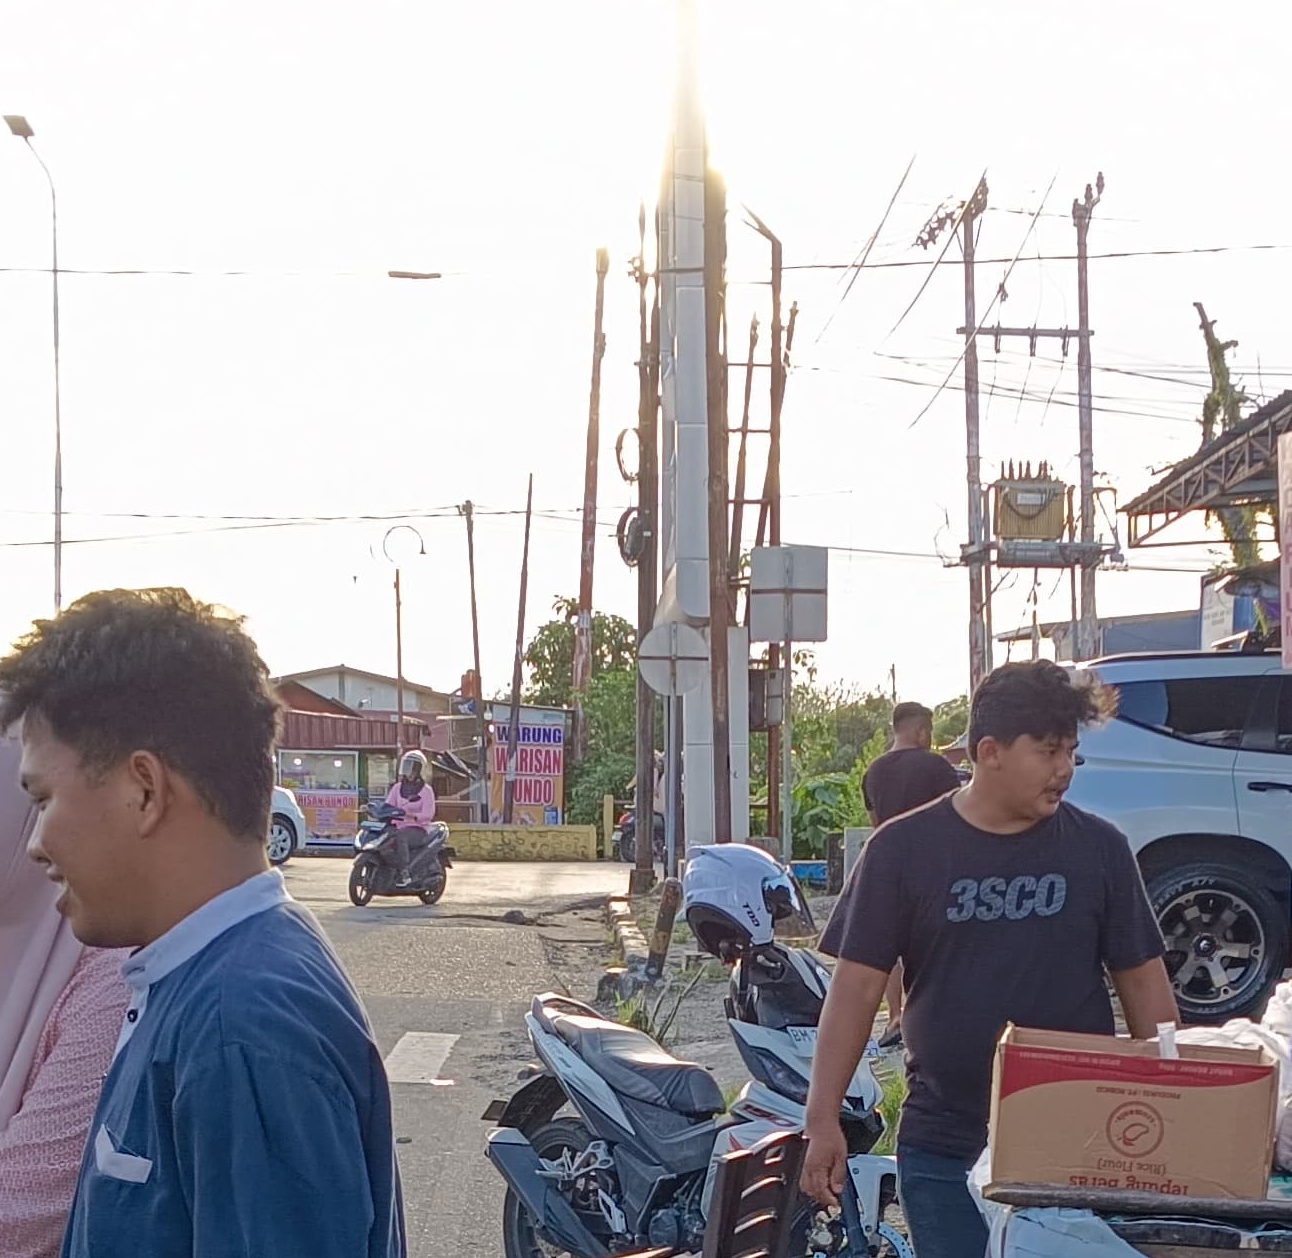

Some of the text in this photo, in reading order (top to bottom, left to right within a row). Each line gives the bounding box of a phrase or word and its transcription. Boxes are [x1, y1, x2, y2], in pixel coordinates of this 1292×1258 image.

[505, 777, 555, 806] UNDO
[947, 873, 1068, 923] 3SCO
[791, 1027, 809, 1043] BM
